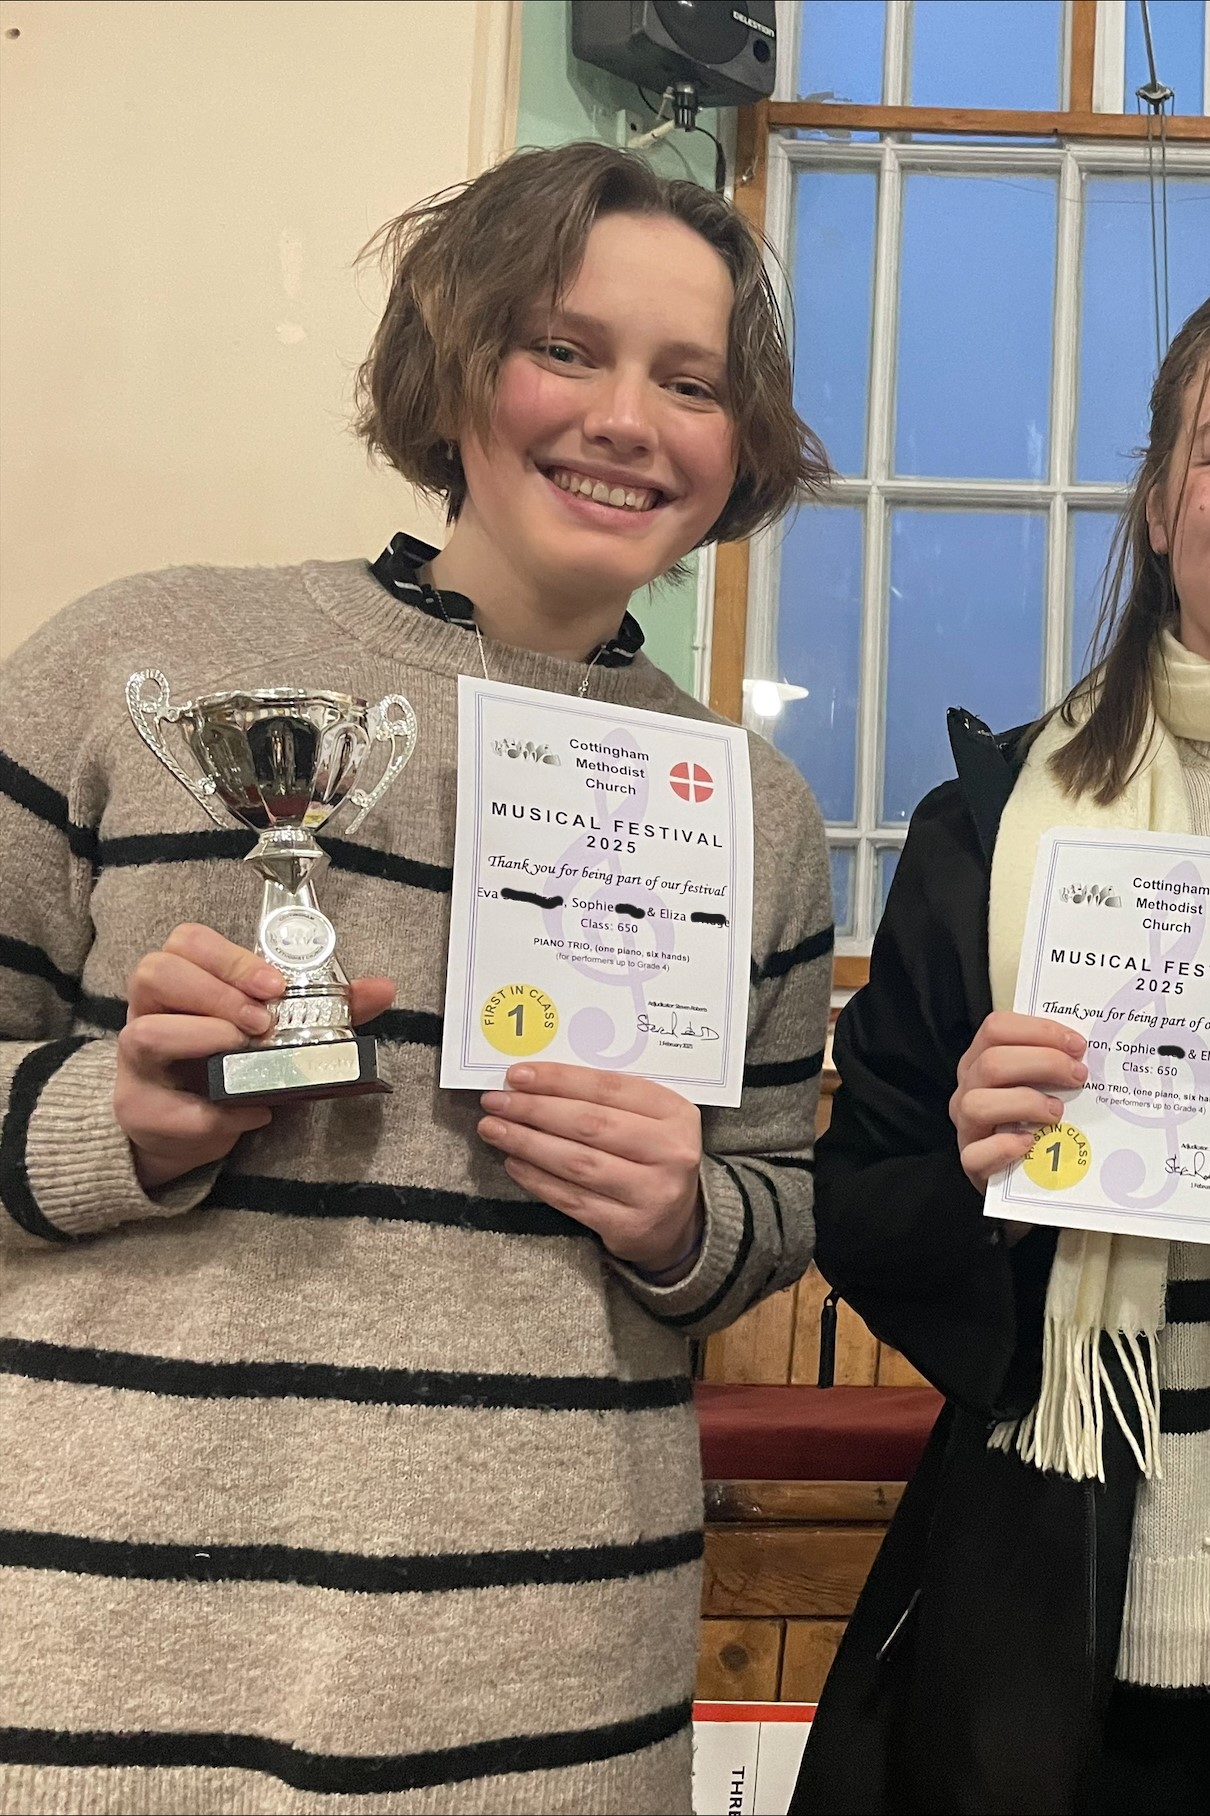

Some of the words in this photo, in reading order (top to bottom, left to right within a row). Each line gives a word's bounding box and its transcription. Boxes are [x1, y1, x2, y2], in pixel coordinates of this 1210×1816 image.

[570, 738, 649, 761] Cottingham
[576, 758, 646, 778] Methodist
[585, 778, 636, 795] Church
[492, 802, 601, 830] MUSICAL
[614, 820, 723, 848] FESTIVAL
[587, 835, 636, 854] 2025
[488, 855, 531, 874] Thank
[530, 863, 556, 875] you
[556, 864, 579, 878] for
[582, 866, 612, 885] being
[616, 873, 642, 886] part
[645, 875, 659, 890] of
[661, 880, 681, 890] our
[681, 880, 728, 897] festival
[1133, 877, 1210, 896] Cottingham
[477, 887, 498, 900] Eva
[572, 897, 615, 913] Sophie
[647, 907, 656, 918] &
[660, 908, 687, 922] Eliza
[1136, 897, 1203, 915] Methodist
[580, 918, 614, 932] Class:
[617, 922, 639, 934] 650
[1142, 918, 1192, 934] Church
[533, 937, 564, 948] PIANO
[567, 940, 593, 952] TRIO,
[595, 943, 616, 955] (one
[617, 947, 644, 958] piano,
[646, 949, 659, 958] six
[661, 952, 690, 963] hands)
[556, 952, 569, 961] (for
[571, 953, 614, 966] performers
[616, 959, 626, 968] up
[627, 959, 636, 968] to
[637, 960, 661, 971] Grade
[662, 963, 670, 973] 4)
[1051, 949, 1152, 972] MUSICAL
[1135, 978, 1184, 995] 2025
[485, 989, 508, 1026] FIRST
[510, 985, 524, 995] IN
[529, 989, 555, 1029] CLASS
[1043, 1001, 1082, 1019] Thank
[1081, 1008, 1103, 1020] you
[1103, 1007, 1126, 1022] for
[1128, 1011, 1158, 1028] being
[1160, 1015, 1186, 1028] part
[1189, 1017, 1205, 1032] of
[508, 1004, 524, 1037] 1
[1087, 1040, 1111, 1051] ron,
[1116, 1041, 1156, 1056] Sophie
[1188, 1050, 1197, 1060] &
[1122, 1062, 1153, 1074] Class:
[1157, 1066, 1178, 1077] 650
[1082, 1082, 1105, 1091] IANO
[1107, 1084, 1131, 1095] TRIO,
[1133, 1087, 1153, 1097] (one
[1154, 1089, 1181, 1101] piano,
[1183, 1093, 1196, 1101] six
[1095, 1095, 1109, 1104] (for
[1110, 1096, 1151, 1109] performers
[1152, 1102, 1162, 1111] up
[1163, 1102, 1171, 1110] to
[1173, 1103, 1197, 1114] Grade
[1198, 1105, 1207, 1115] 4)
[1050, 1124, 1062, 1133] IN
[1066, 1127, 1088, 1166] CLASS
[1046, 1141, 1061, 1172] 1
